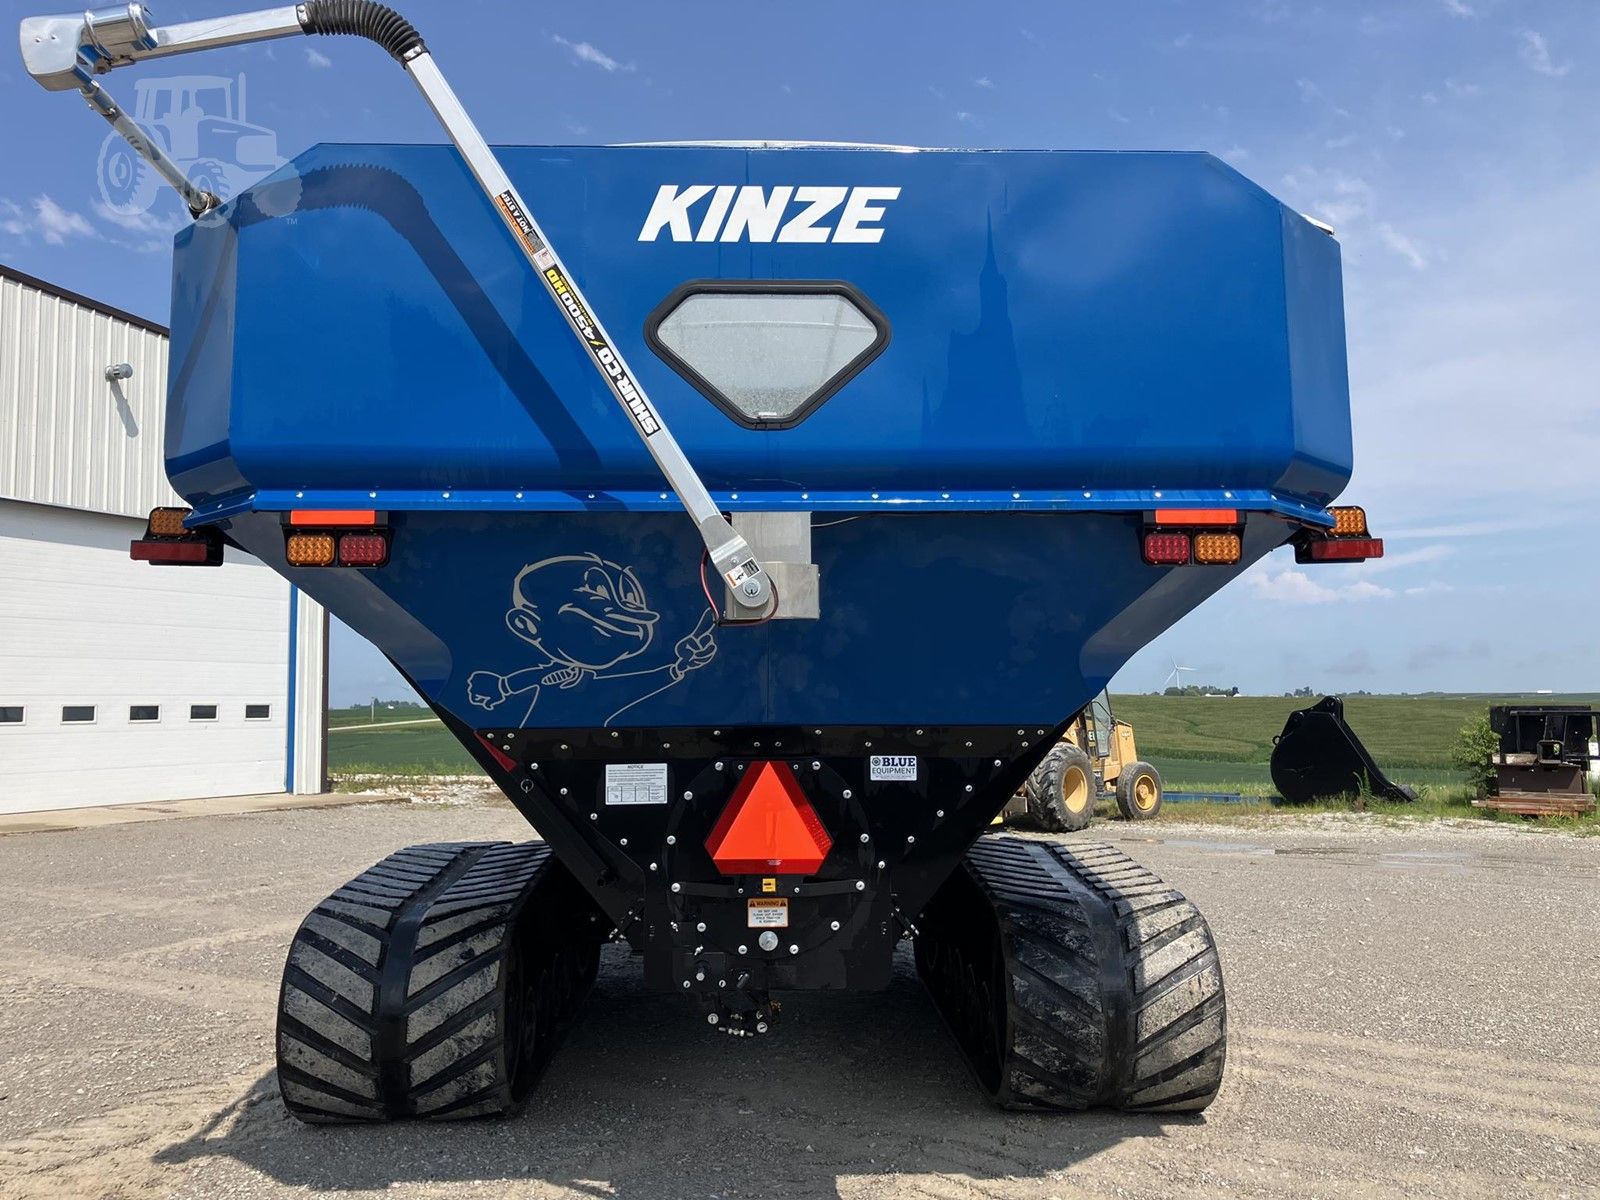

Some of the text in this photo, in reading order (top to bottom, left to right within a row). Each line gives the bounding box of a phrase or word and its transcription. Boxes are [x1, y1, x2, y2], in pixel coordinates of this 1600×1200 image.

[501, 193, 516, 210] STEP
[638, 185, 901, 243] KINZE
[517, 217, 531, 234] NOT
[881, 757, 916, 767] BLUE
